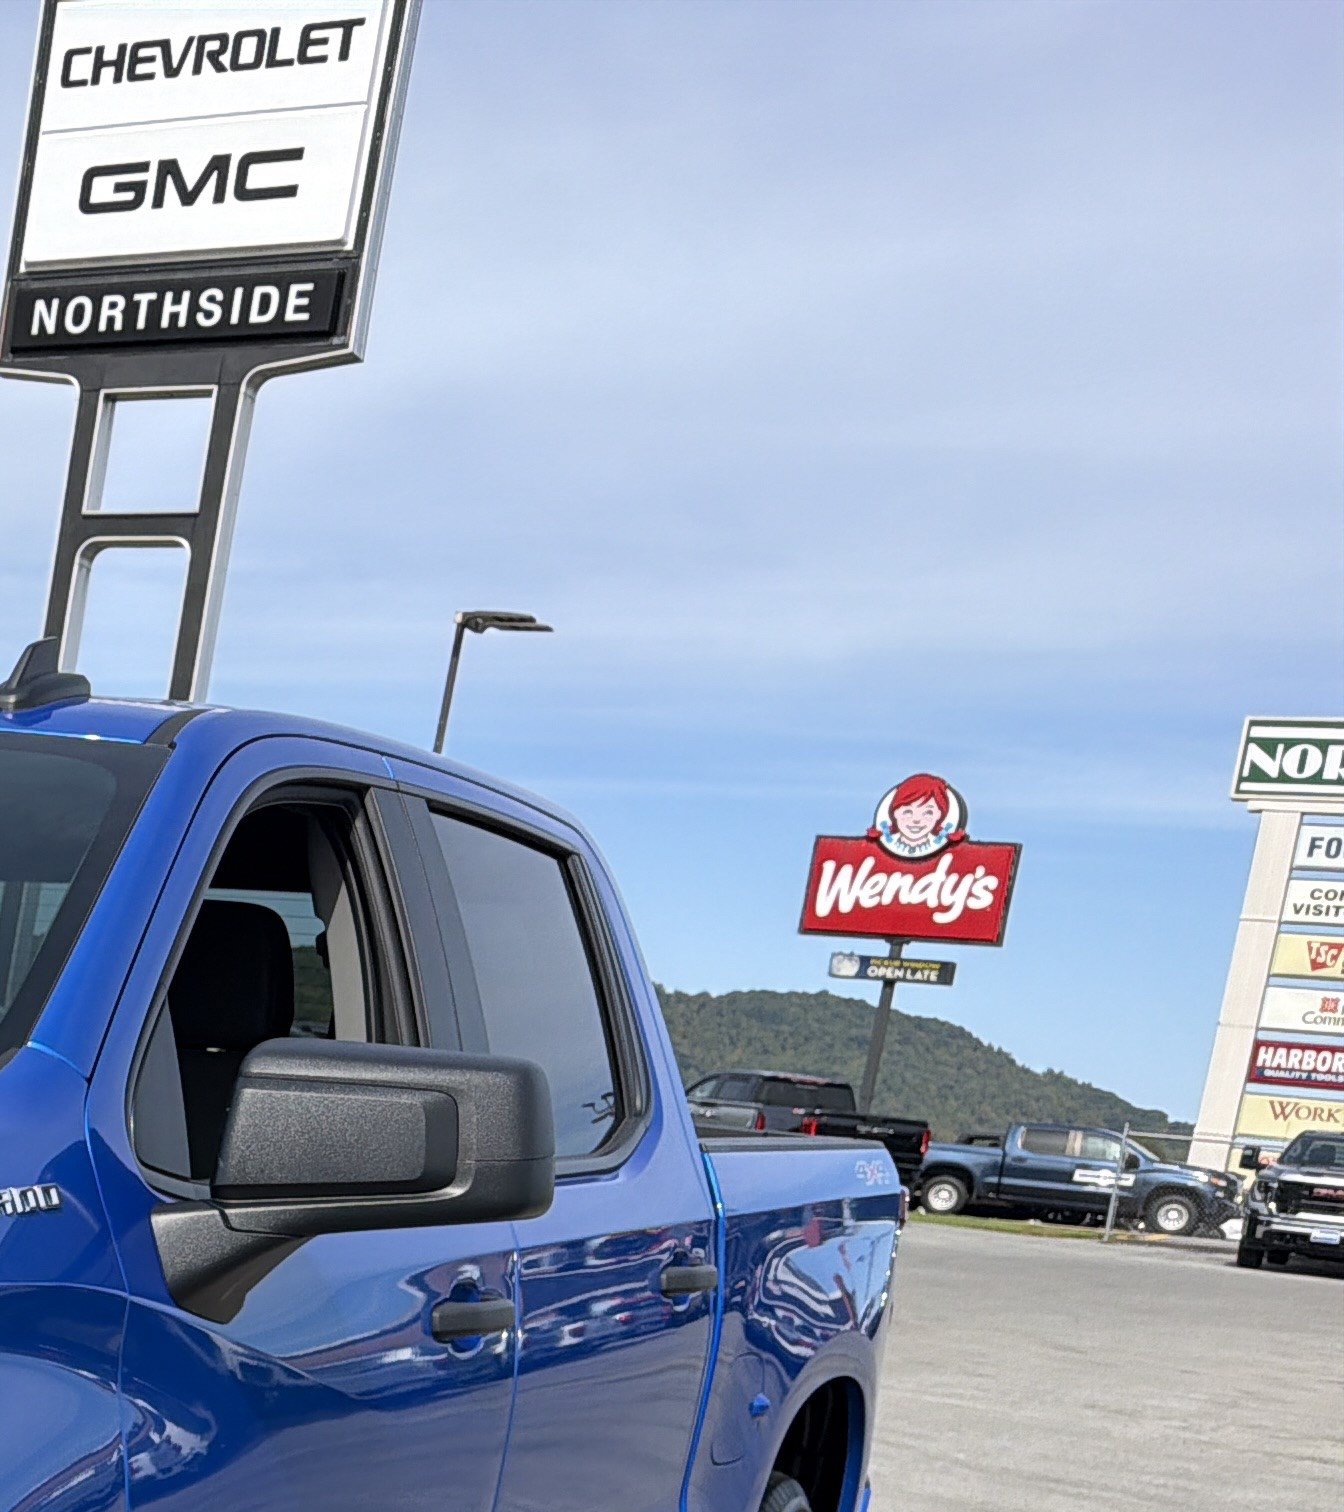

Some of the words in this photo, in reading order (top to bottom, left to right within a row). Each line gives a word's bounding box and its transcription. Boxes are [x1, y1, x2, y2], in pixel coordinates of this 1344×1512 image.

[60, 18, 366, 89] CHEVROLET
[78, 147, 305, 215] GMC
[30, 282, 315, 337] NORTHSIDE
[815, 852, 999, 924] Wendy's
[867, 965, 905, 979] OPEN
[906, 968, 939, 982] LATE
[1311, 942, 1338, 968] TSC
[1256, 1045, 1344, 1073] HARBOR
